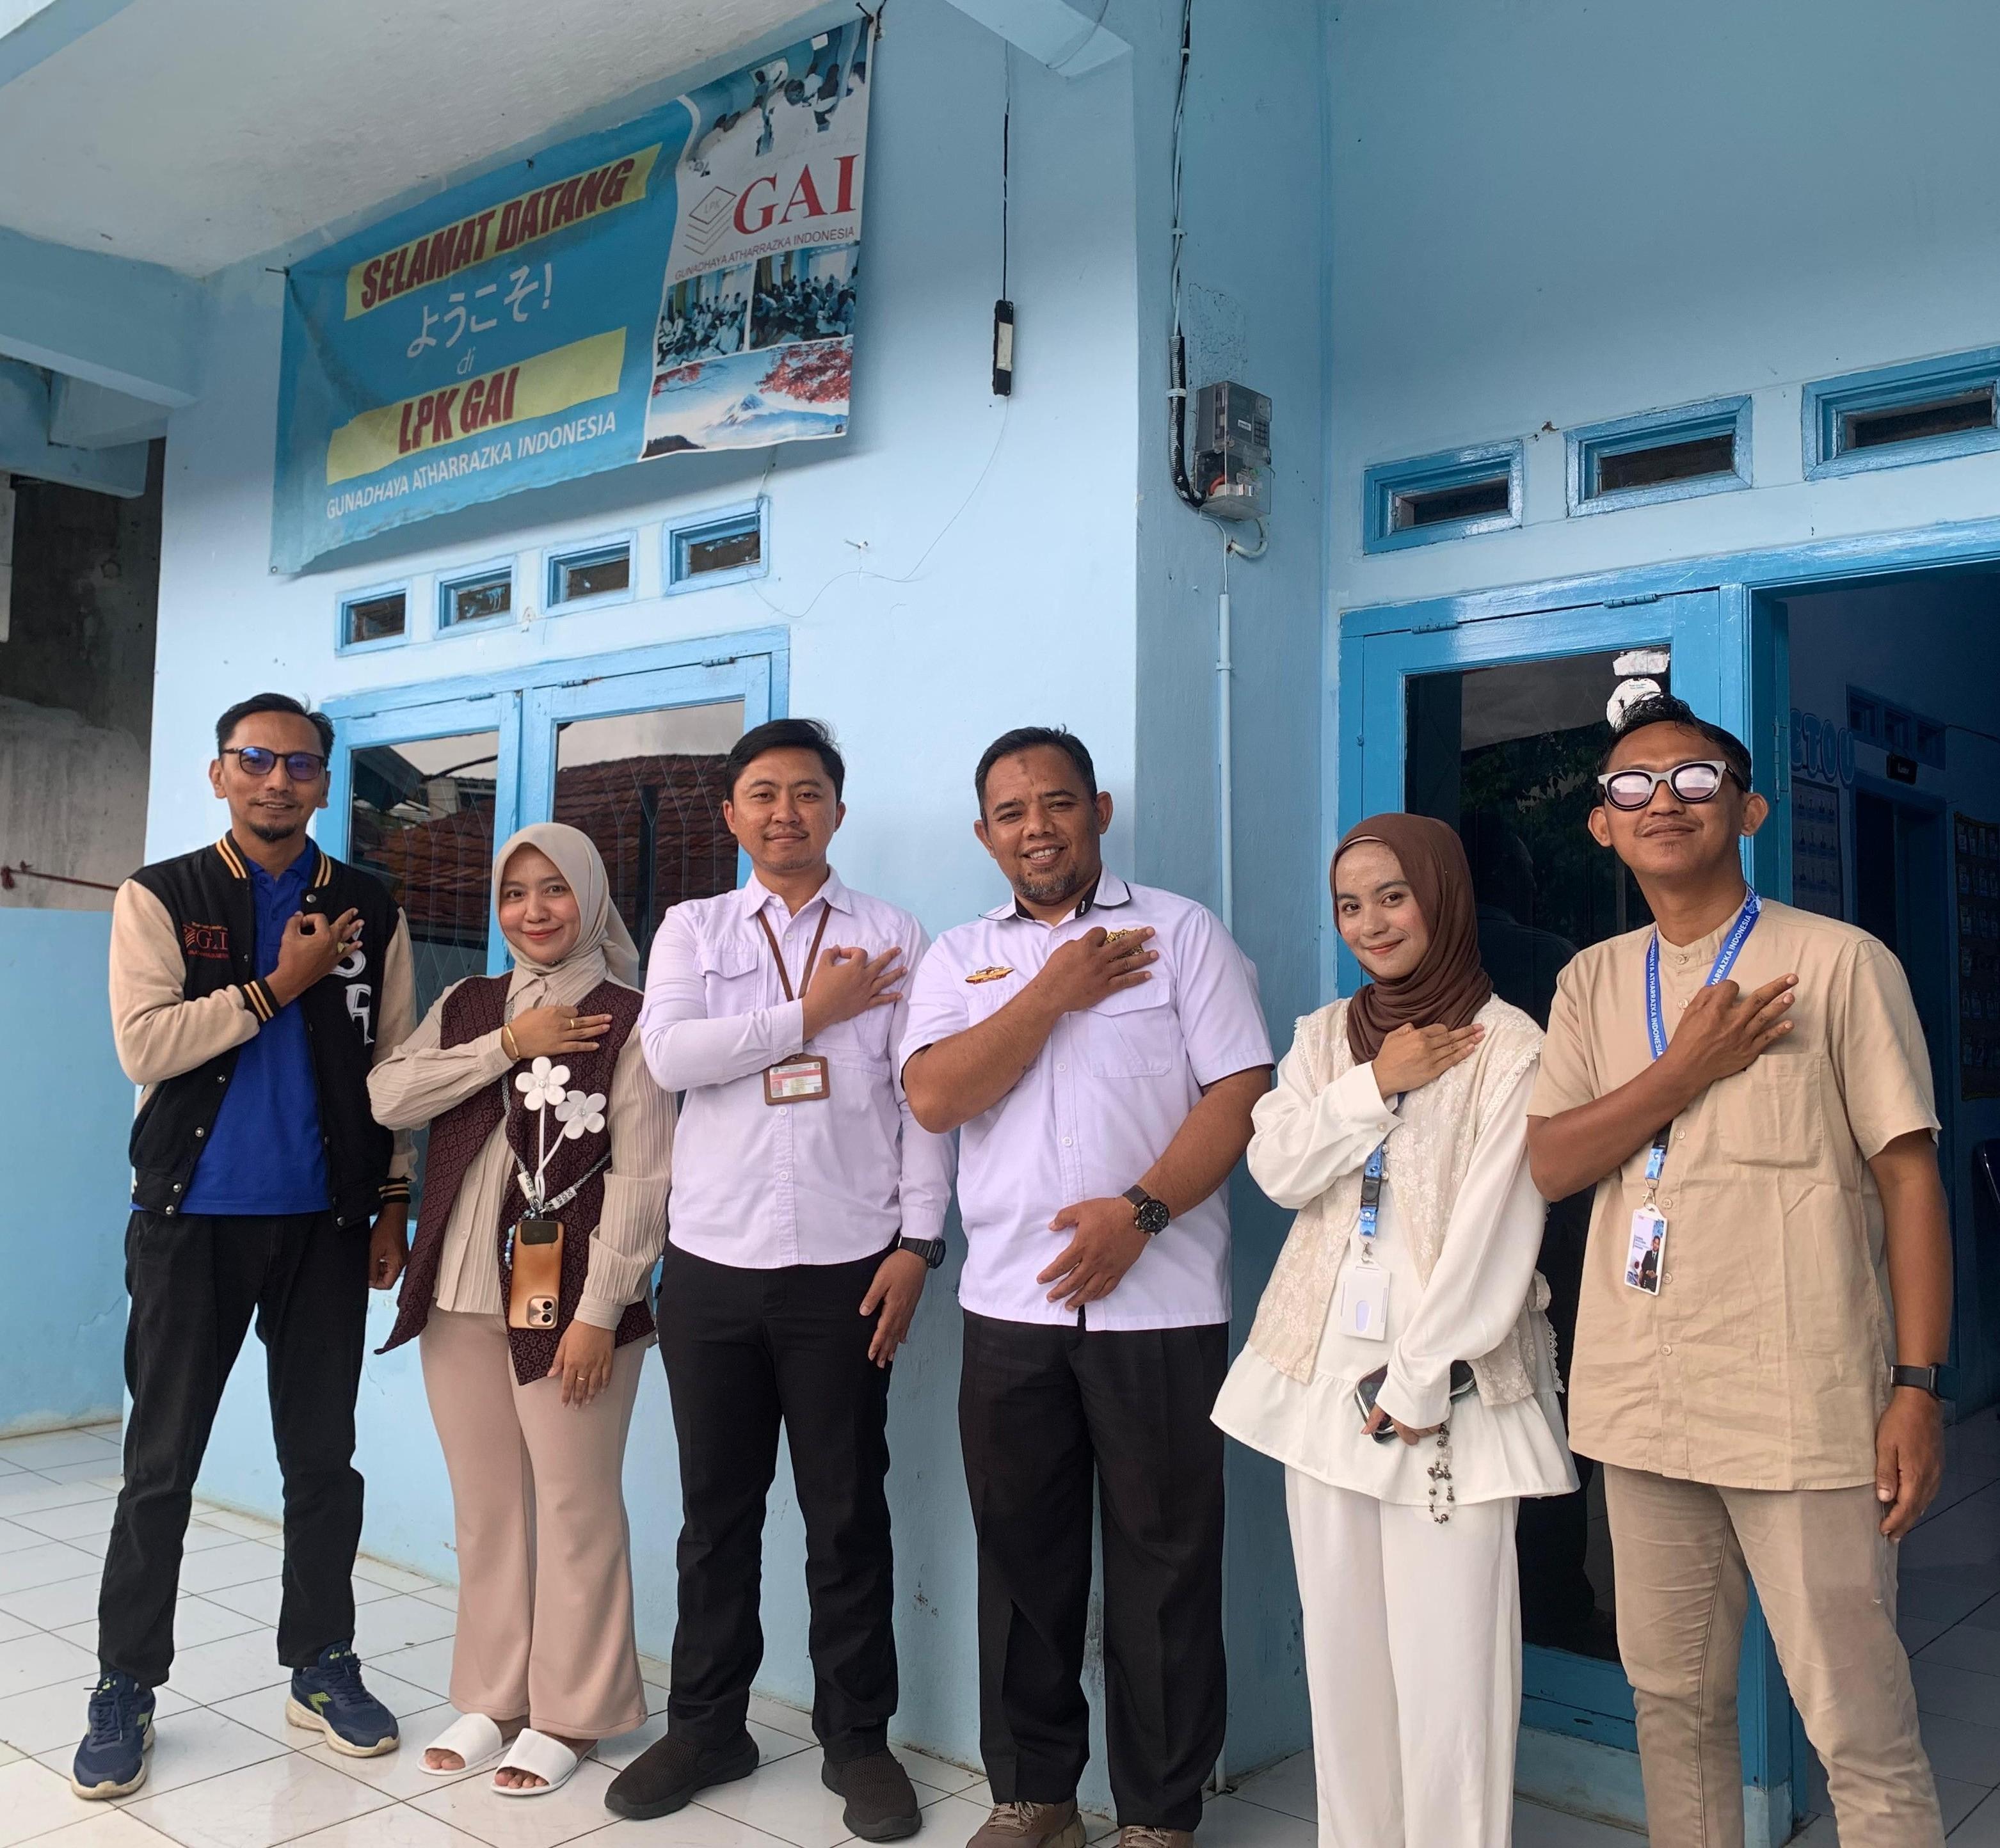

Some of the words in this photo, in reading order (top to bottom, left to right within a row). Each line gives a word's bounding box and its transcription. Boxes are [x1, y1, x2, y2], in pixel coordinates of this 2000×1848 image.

[733, 154, 860, 235] GAI
[361, 209, 497, 309] SELAMAT
[494, 157, 635, 253] DATANG
[675, 255, 728, 281] GUNADHAYA
[728, 238, 792, 262] ATHARRAZKA
[794, 226, 855, 244] INDONESIA
[456, 347, 476, 375] di
[398, 387, 460, 455] LPK
[459, 366, 520, 434] GAI
[326, 475, 409, 520] GUNADHAYA
[412, 441, 512, 491] ATHARRAZKA
[516, 410, 616, 458] INDONESIA
[1727, 914, 1752, 950] INDONESIA
[1651, 1017, 1663, 1056] INDONESIA
